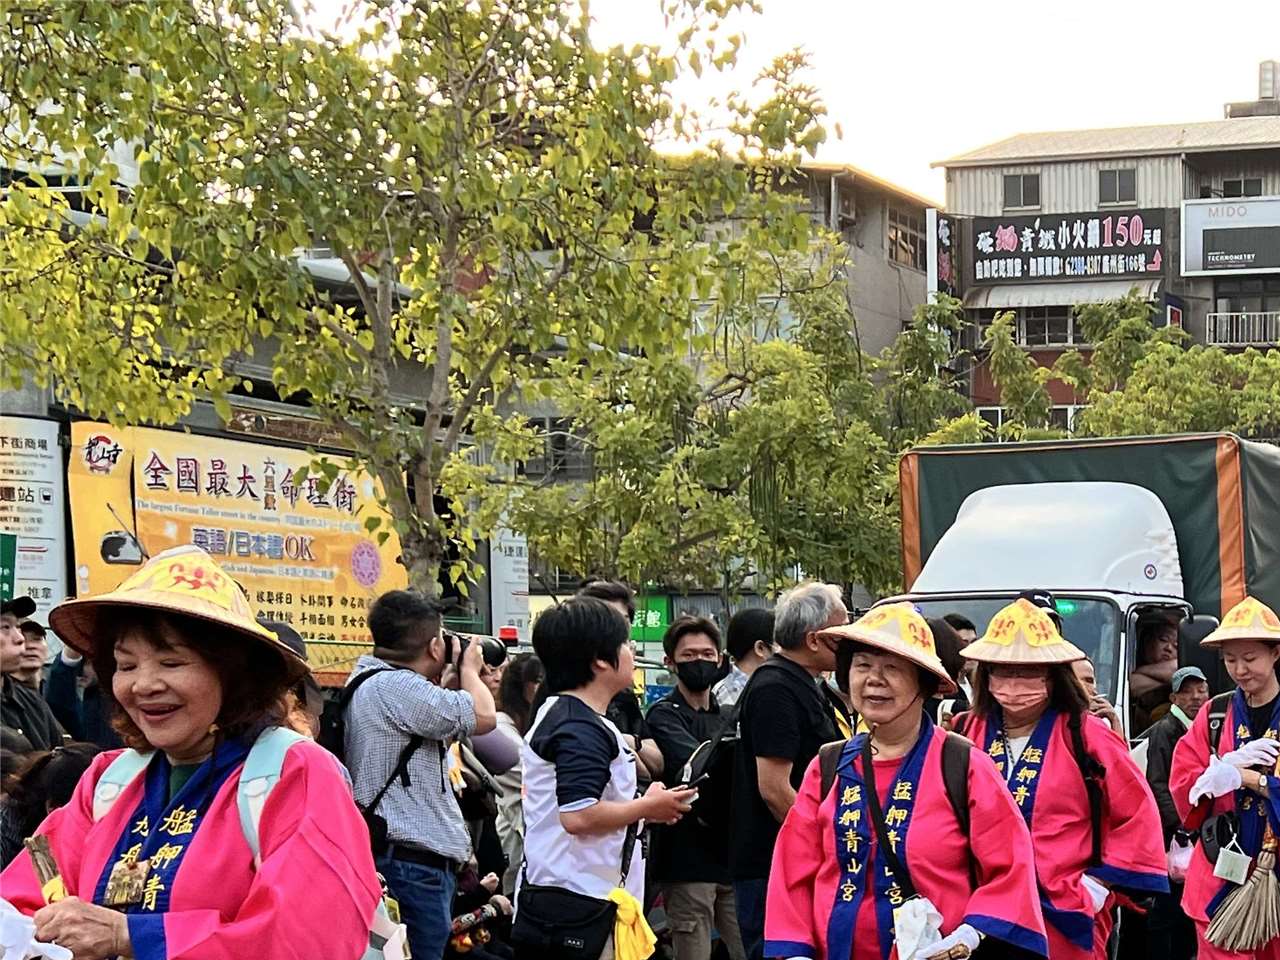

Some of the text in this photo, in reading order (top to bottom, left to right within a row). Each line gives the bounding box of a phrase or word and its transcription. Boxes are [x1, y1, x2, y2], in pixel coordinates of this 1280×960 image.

[1208, 206, 1248, 218] MIDO
[144, 451, 258, 501] 全國最大
[838, 785, 863, 902] 艋舺青山宮
